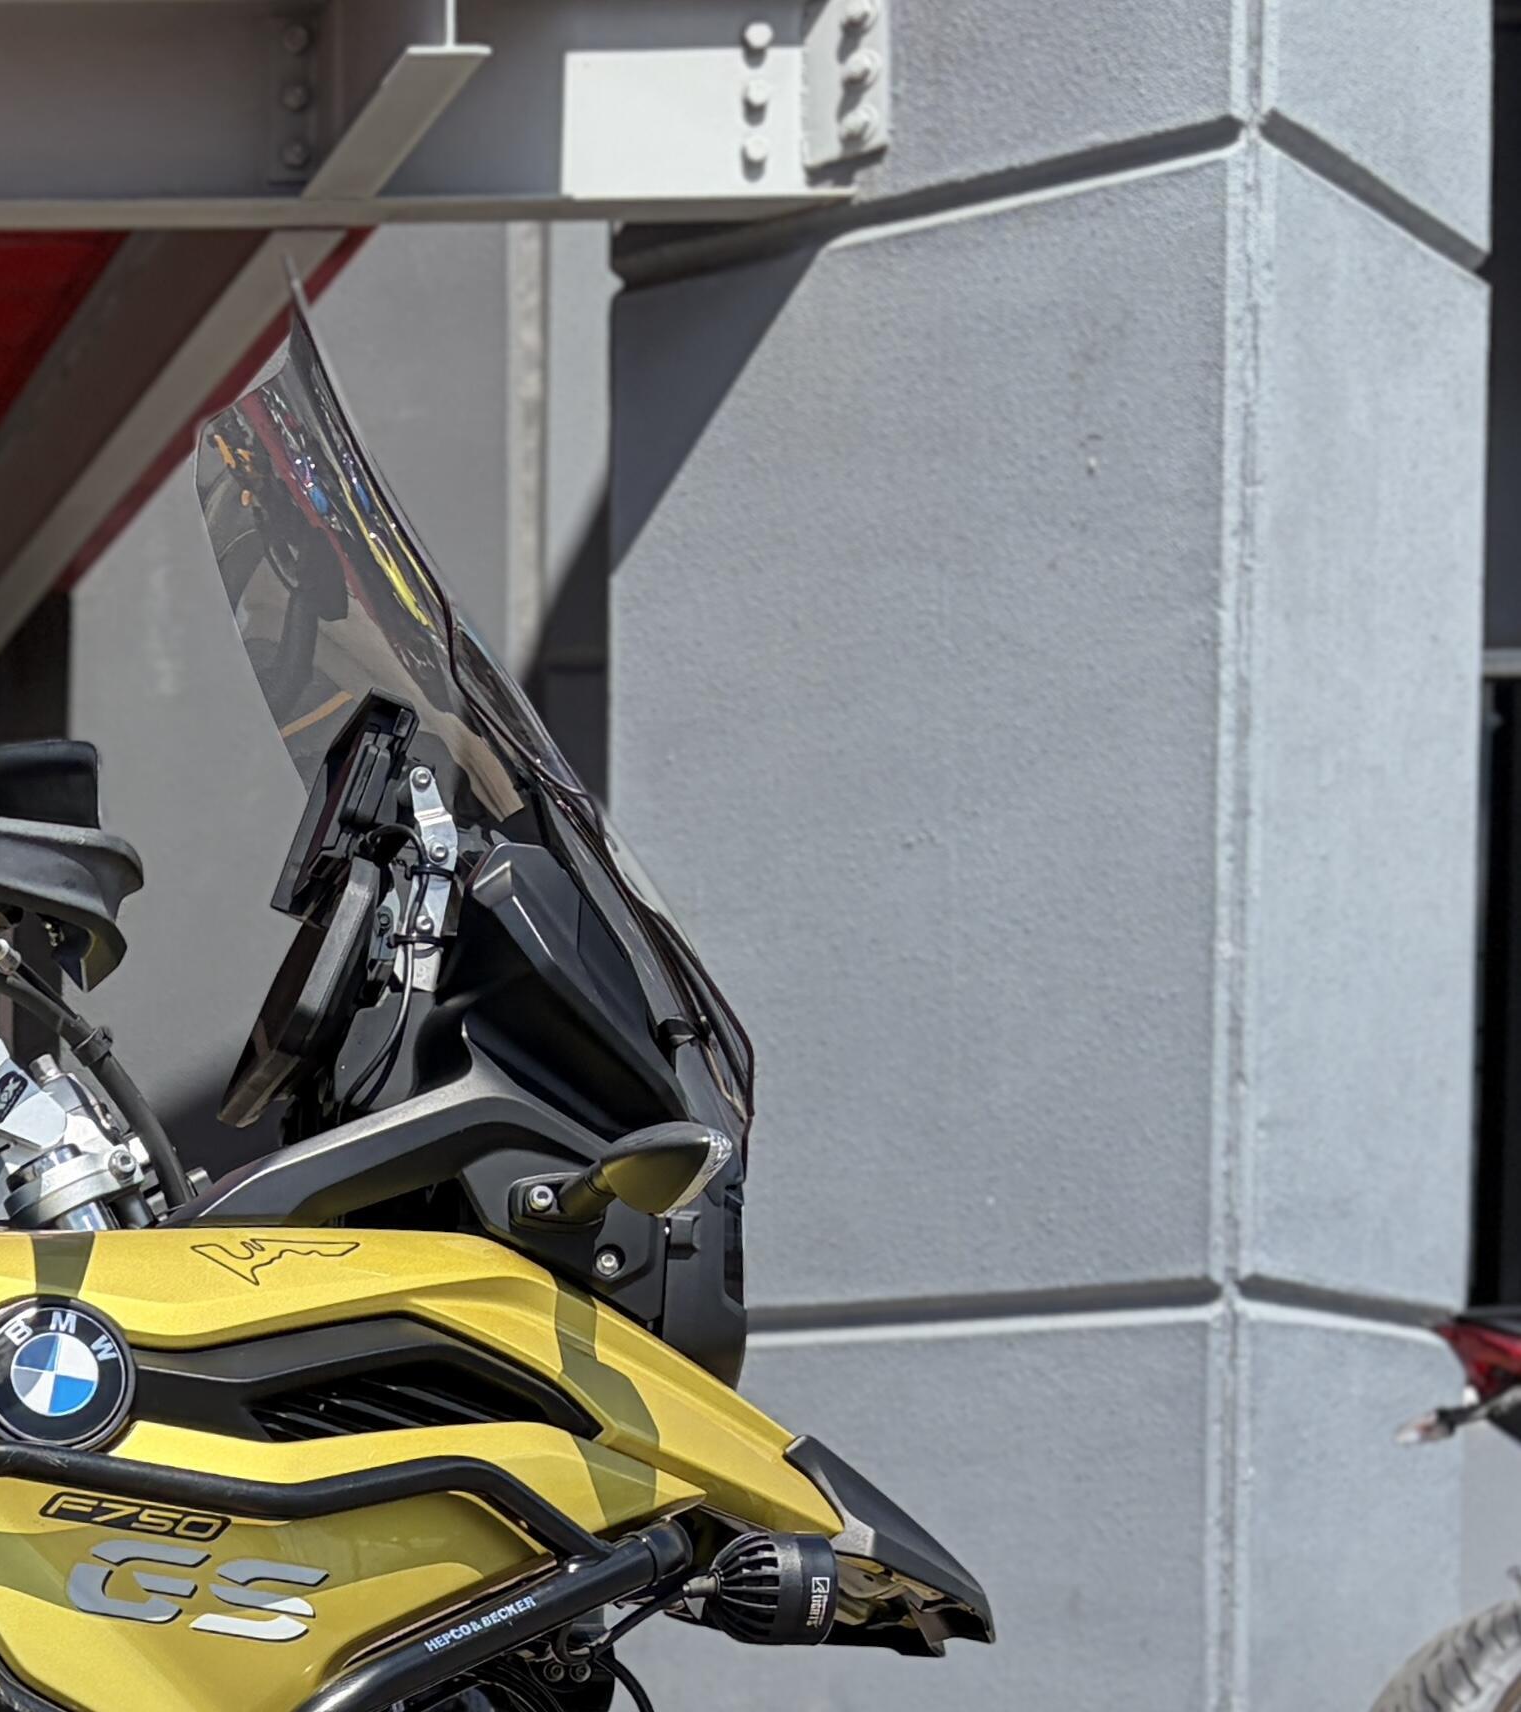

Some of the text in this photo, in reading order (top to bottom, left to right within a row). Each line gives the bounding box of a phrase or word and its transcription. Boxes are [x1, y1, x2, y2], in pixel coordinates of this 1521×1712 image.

[5, 1310, 118, 1361] BMW
[47, 1496, 219, 1538] F750
[68, 1540, 328, 1641] GS
